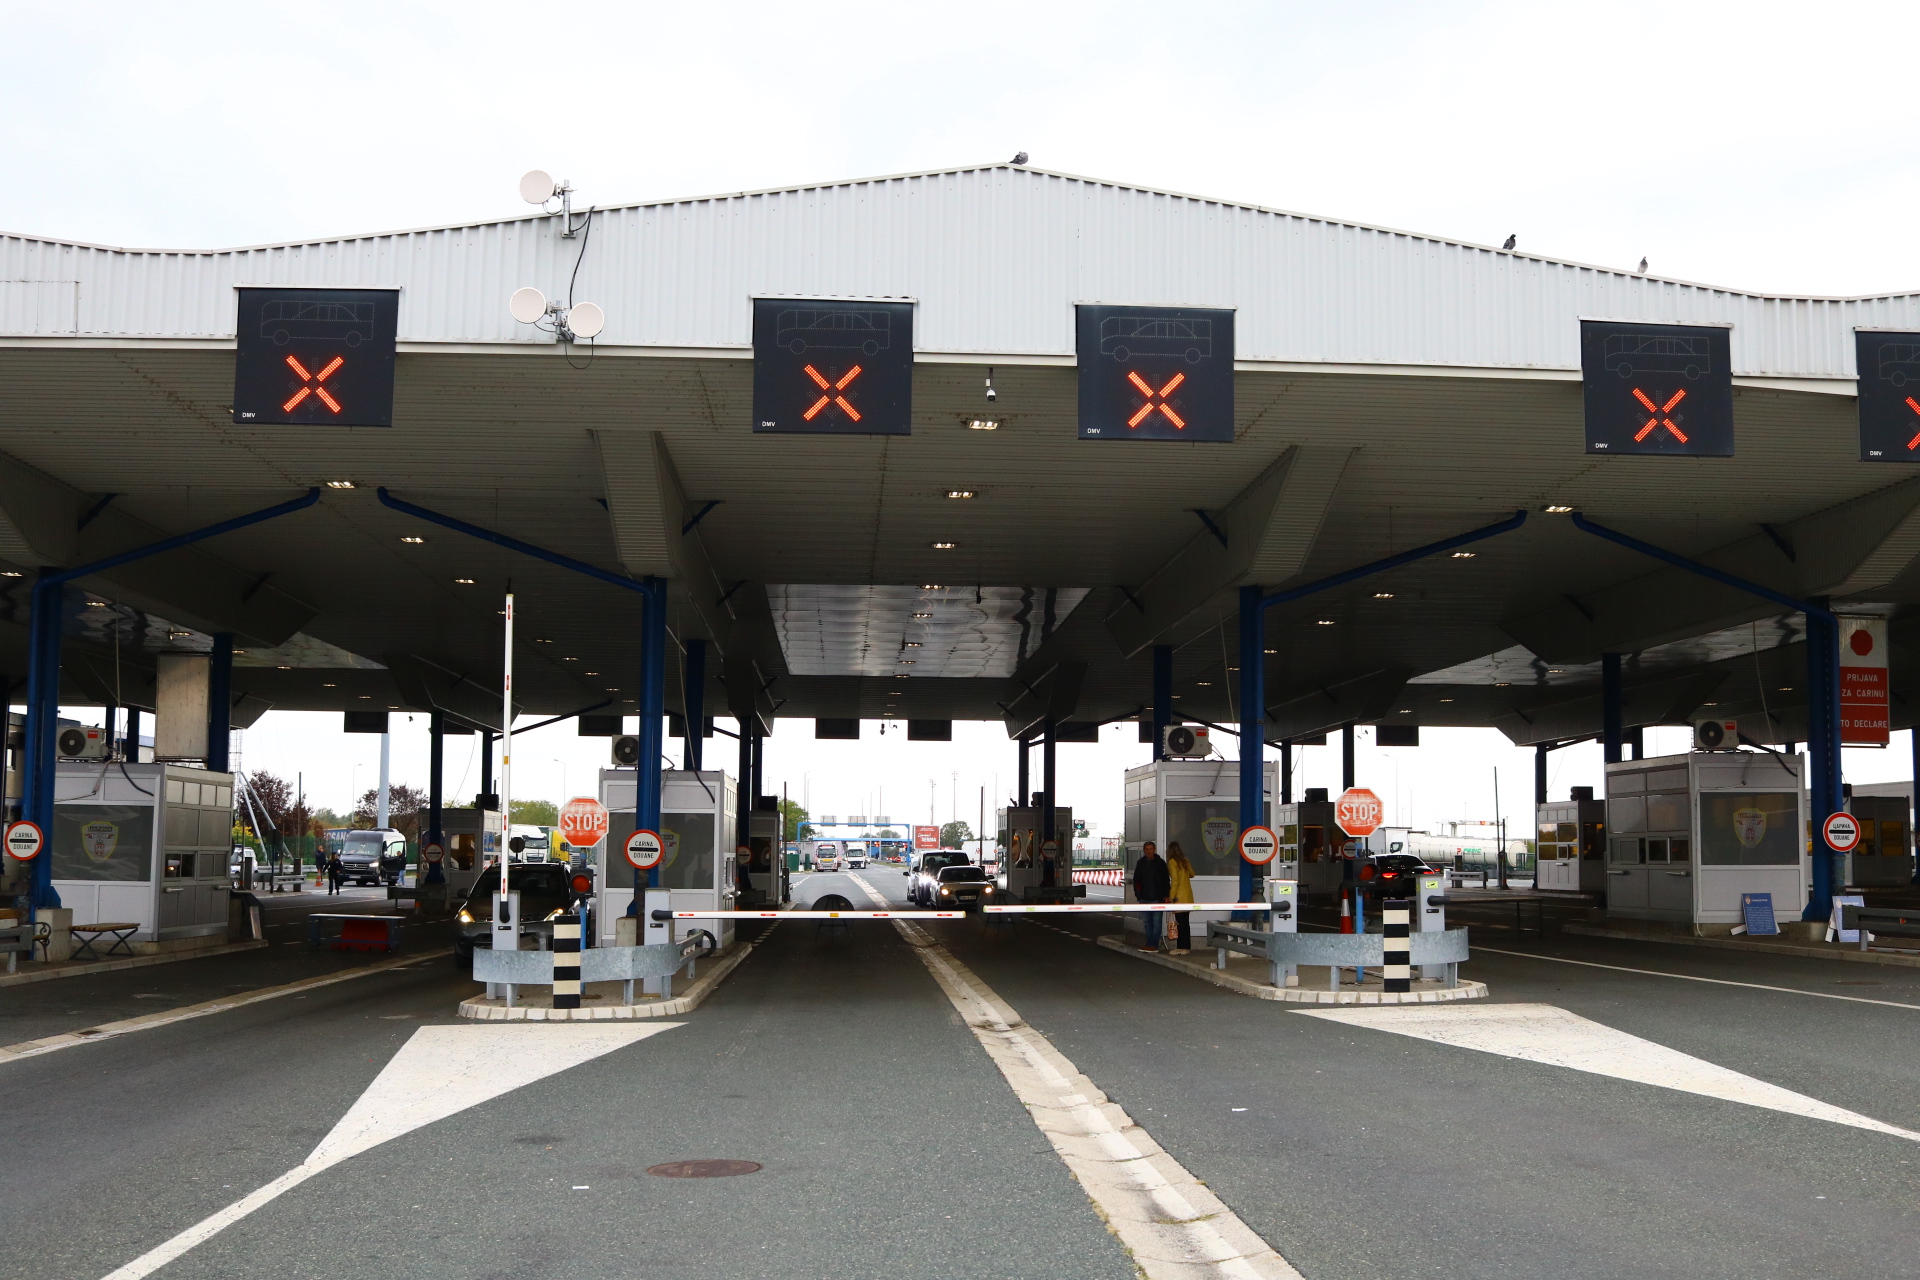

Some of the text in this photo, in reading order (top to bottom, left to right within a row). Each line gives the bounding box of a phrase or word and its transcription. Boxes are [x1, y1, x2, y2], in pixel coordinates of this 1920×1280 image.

[1846, 673, 1879, 682] PRIJAVA
[1841, 688, 1885, 698] ZA CARINU
[1840, 719, 1888, 728] TO DECLARE
[1341, 803, 1378, 821] STOP
[564, 813, 603, 831] STOP
